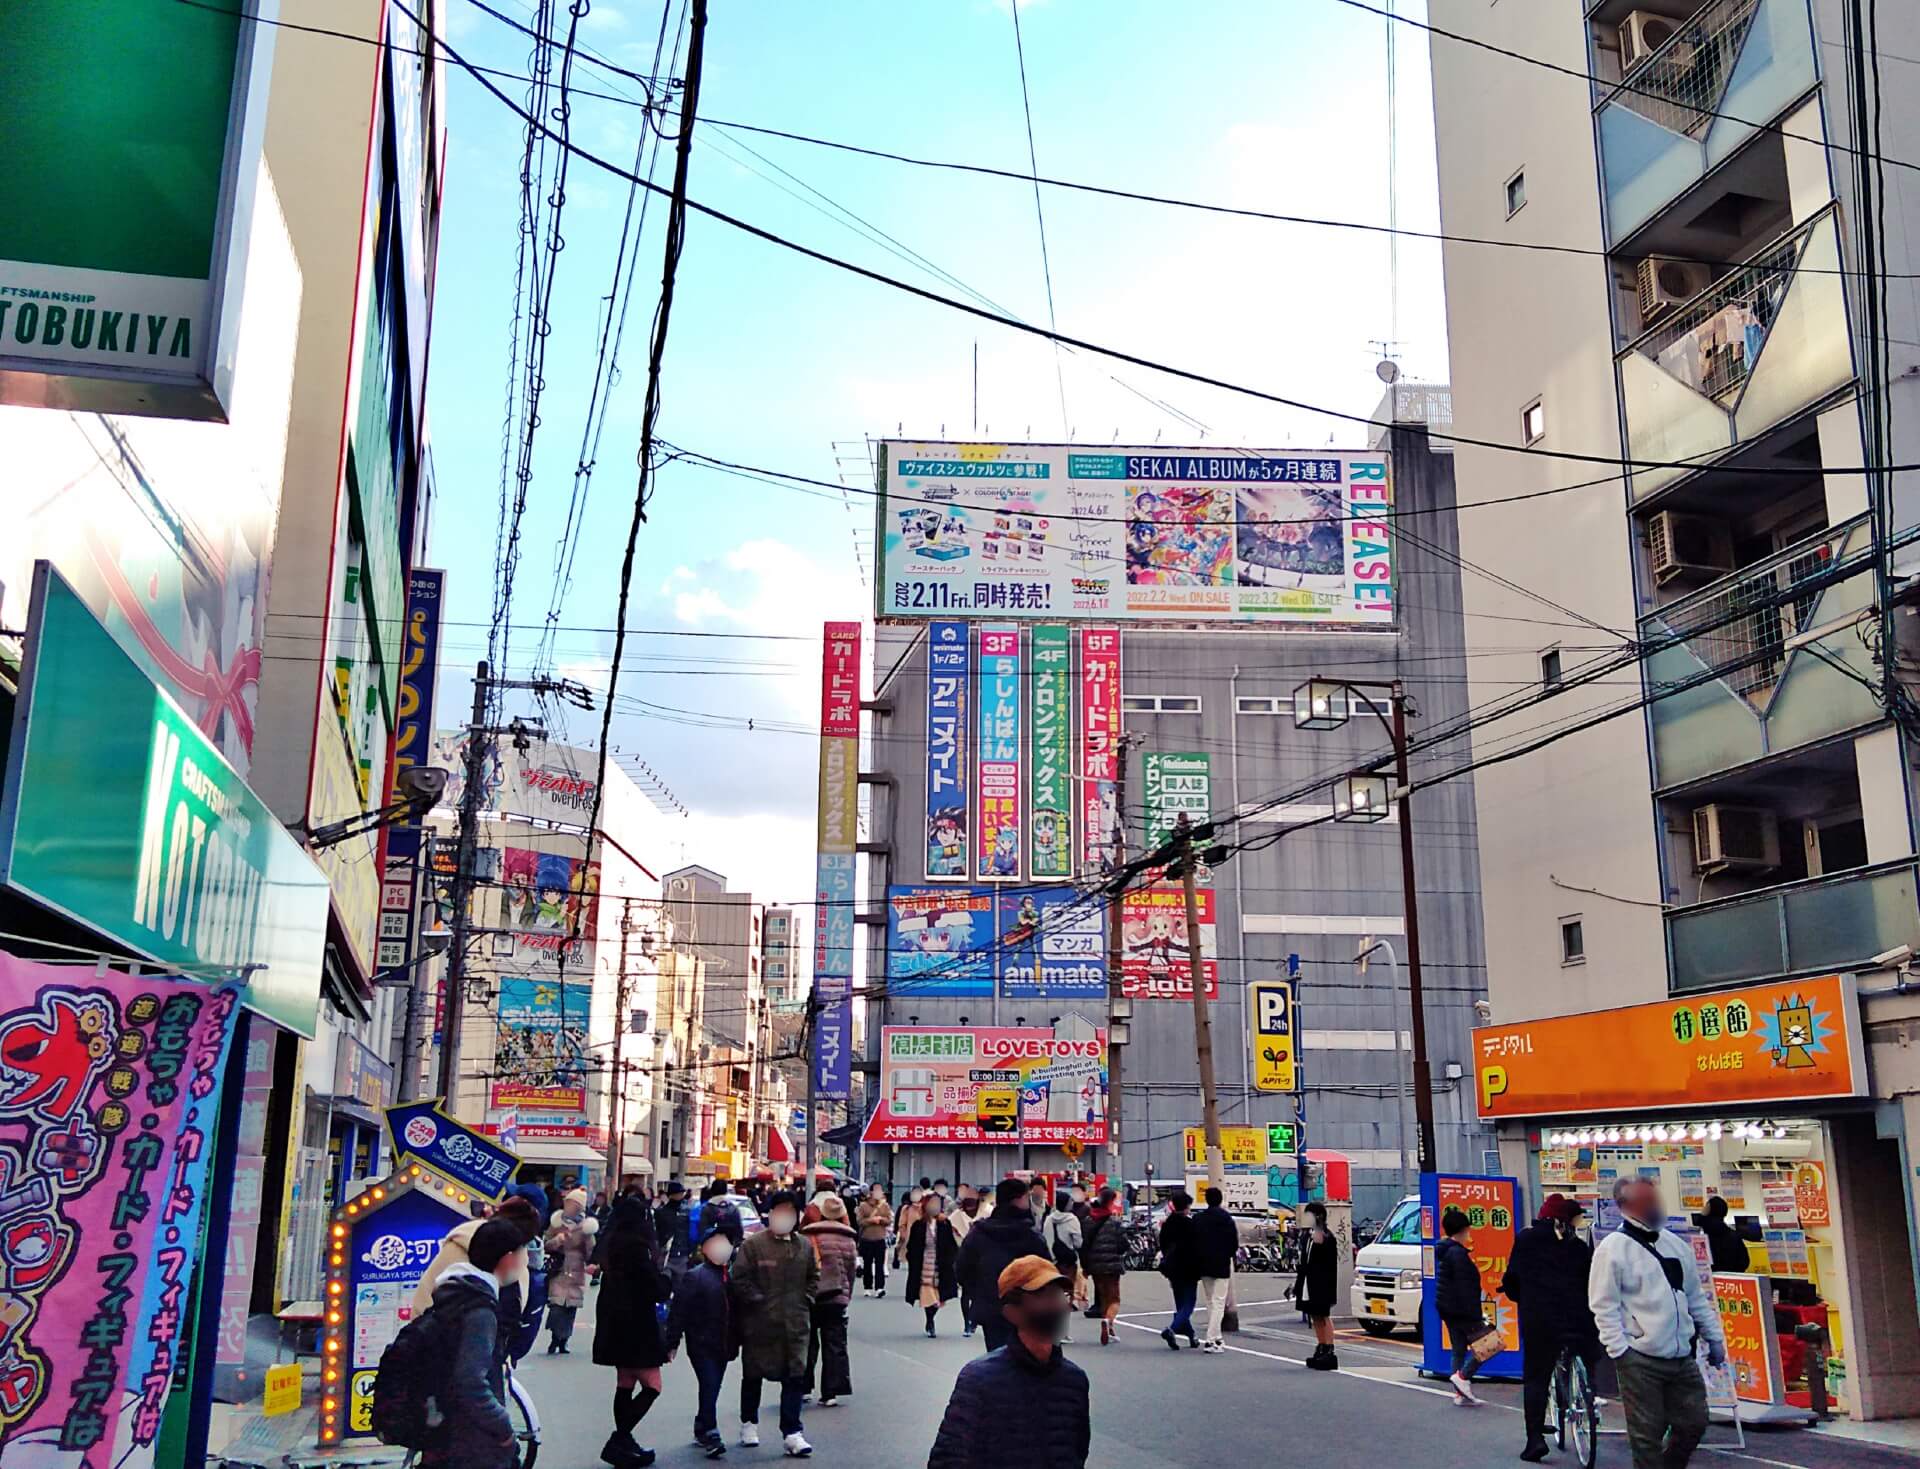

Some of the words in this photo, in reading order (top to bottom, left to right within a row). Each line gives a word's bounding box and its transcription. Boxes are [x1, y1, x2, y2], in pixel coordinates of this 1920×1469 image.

[1129, 457, 1180, 478] SEKAI
[1350, 462, 1393, 611] RELEASE!
[986, 636, 1013, 652] 3F
[1087, 636, 1113, 650] 5F
[1035, 650, 1066, 662] 4F
[829, 641, 854, 721] カードラボ
[995, 659, 1015, 760] らしんばん
[1086, 660, 1109, 777] カードラボ
[932, 677, 957, 793] アニメイト
[1037, 669, 1056, 804] メロンブックス
[827, 856, 846, 867] 3F
[390, 888, 404, 896] PC
[385, 916, 403, 925] 中古
[1052, 938, 1093, 950] マンガ
[1004, 962, 1104, 985] animate
[1259, 992, 1285, 1030] P
[1271, 1019, 1288, 1030] 24h
[1673, 1004, 1749, 1041] 特選館
[891, 1034, 973, 1056] 信長書店
[982, 1040, 1043, 1057] LOVE
[1044, 1040, 1100, 1058] TOYS
[1483, 1033, 1533, 1057] デジタル
[1696, 1051, 1744, 1071] なんば店
[1481, 1064, 1508, 1107] P
[1270, 1126, 1292, 1152] 空
[1440, 1183, 1500, 1200] デジタル
[370, 1235, 438, 1270] 駿河
[1472, 1256, 1507, 1273] フル
[362, 1271, 400, 1280] SURUGAYA
[1715, 1281, 1744, 1295] デジタル
